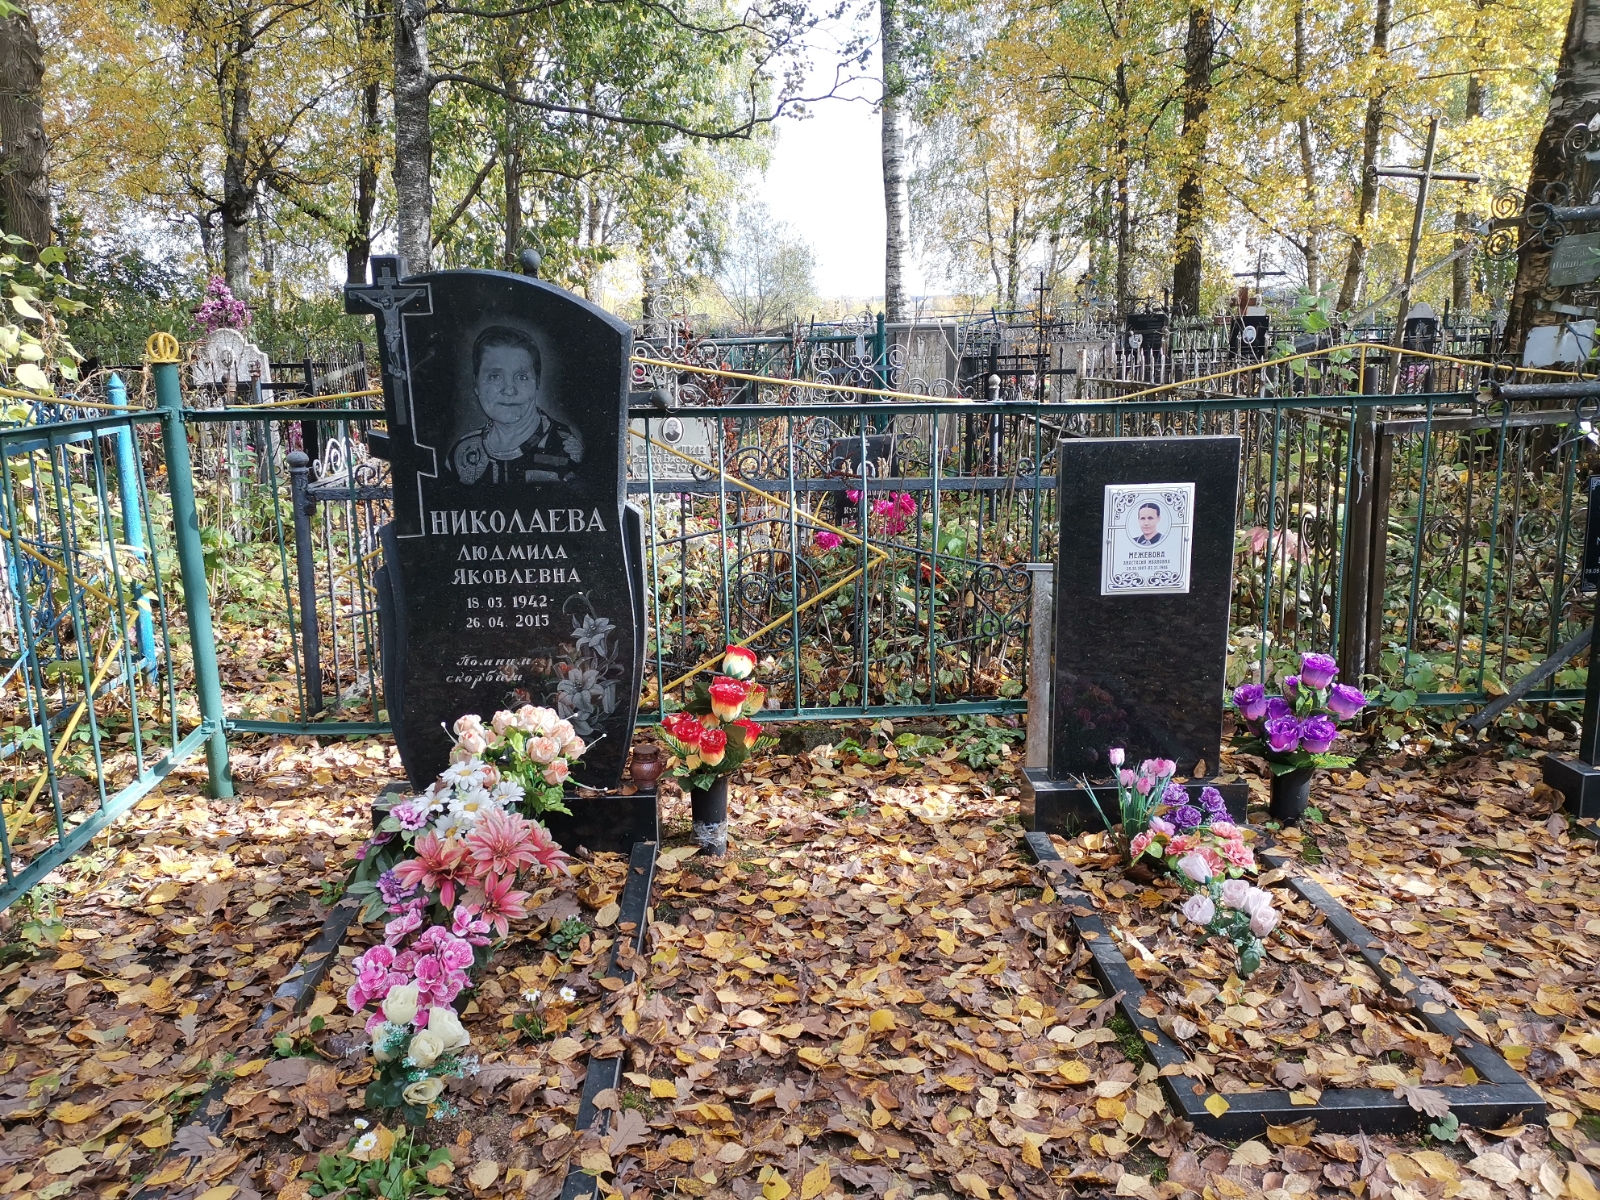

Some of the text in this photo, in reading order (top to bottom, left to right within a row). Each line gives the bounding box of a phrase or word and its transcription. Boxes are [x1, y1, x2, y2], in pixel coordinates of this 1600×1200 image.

[430, 507, 607, 536] НИКОЛАЕВА
[457, 544, 568, 561] ЛЮДМИЛА
[451, 567, 582, 585] ЯКОВЛЕВНА
